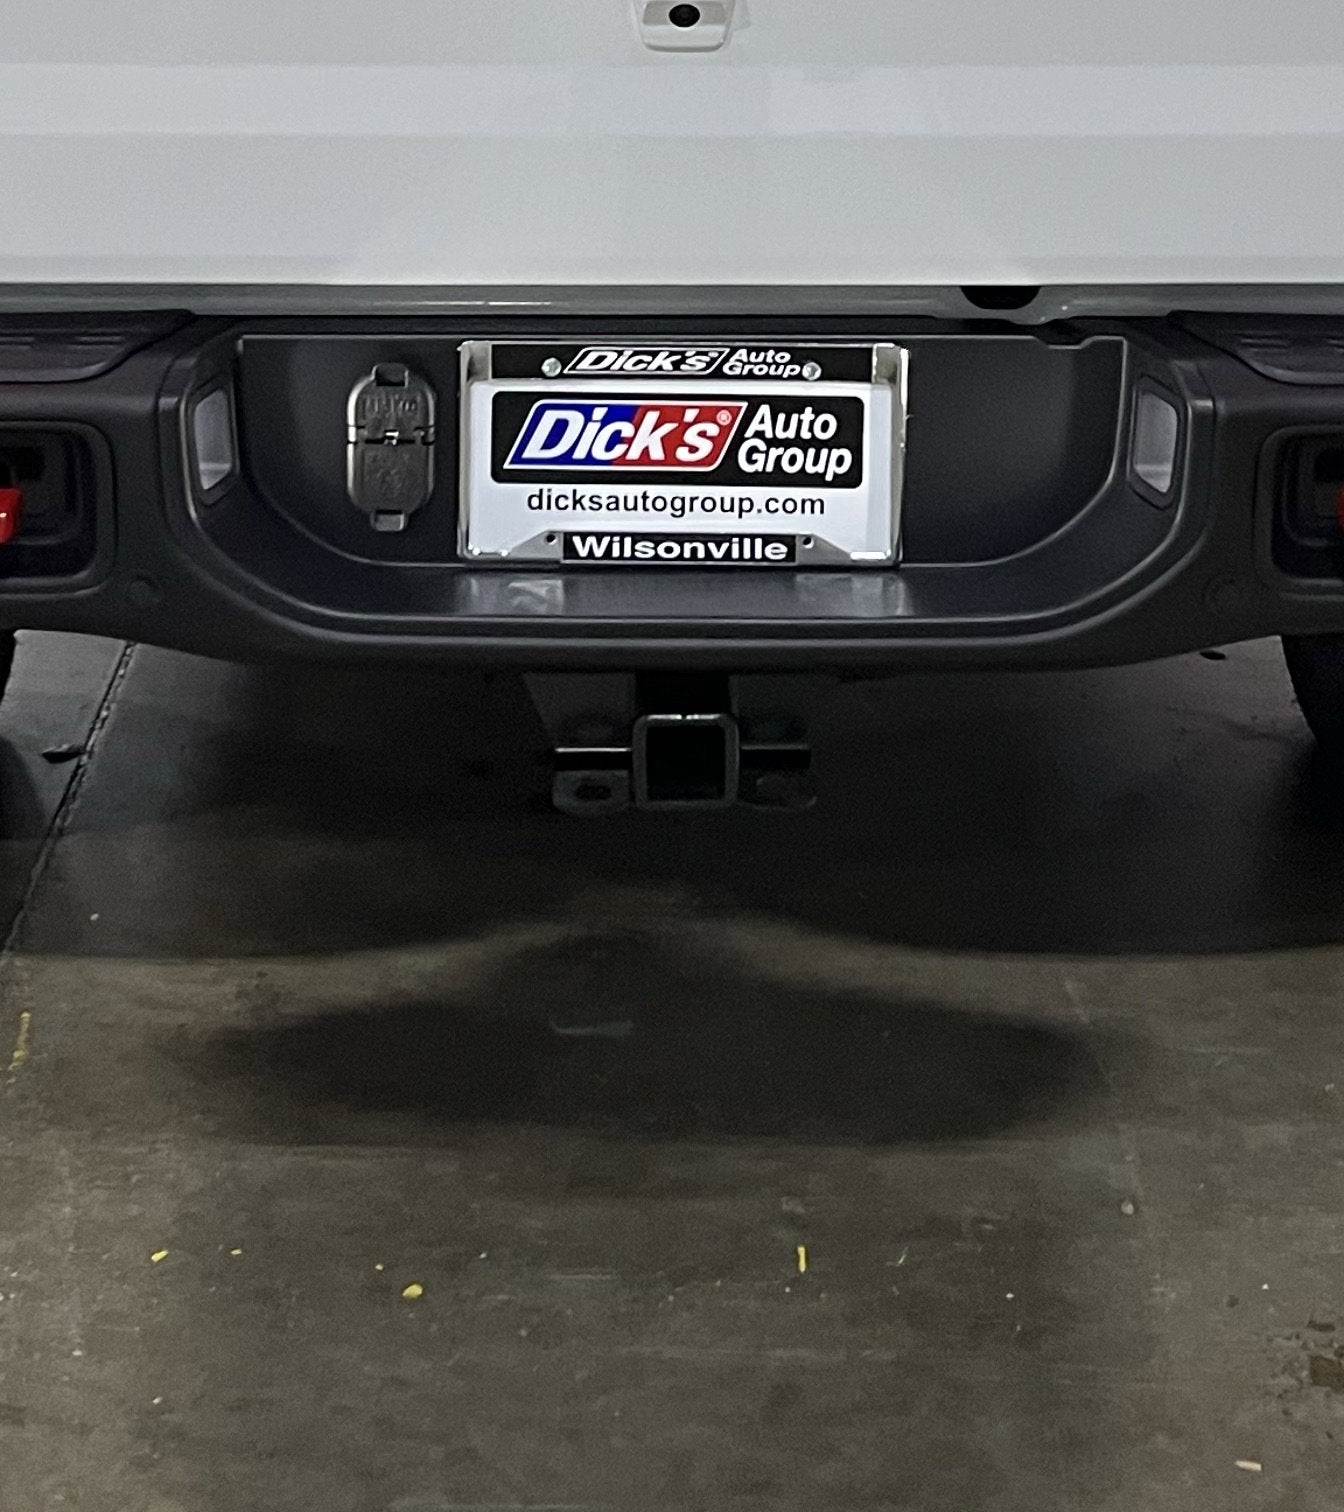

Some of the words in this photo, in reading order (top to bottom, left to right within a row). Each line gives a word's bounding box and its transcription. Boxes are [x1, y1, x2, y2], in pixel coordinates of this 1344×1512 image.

[574, 349, 711, 372] Dick's
[726, 348, 792, 364] Auto
[723, 362, 801, 379] Group
[521, 406, 720, 463] Dick's
[744, 403, 839, 440] Auto
[737, 438, 853, 482] Group
[527, 488, 826, 519] dicksautogroup.com
[572, 535, 789, 560] Wilsonville
